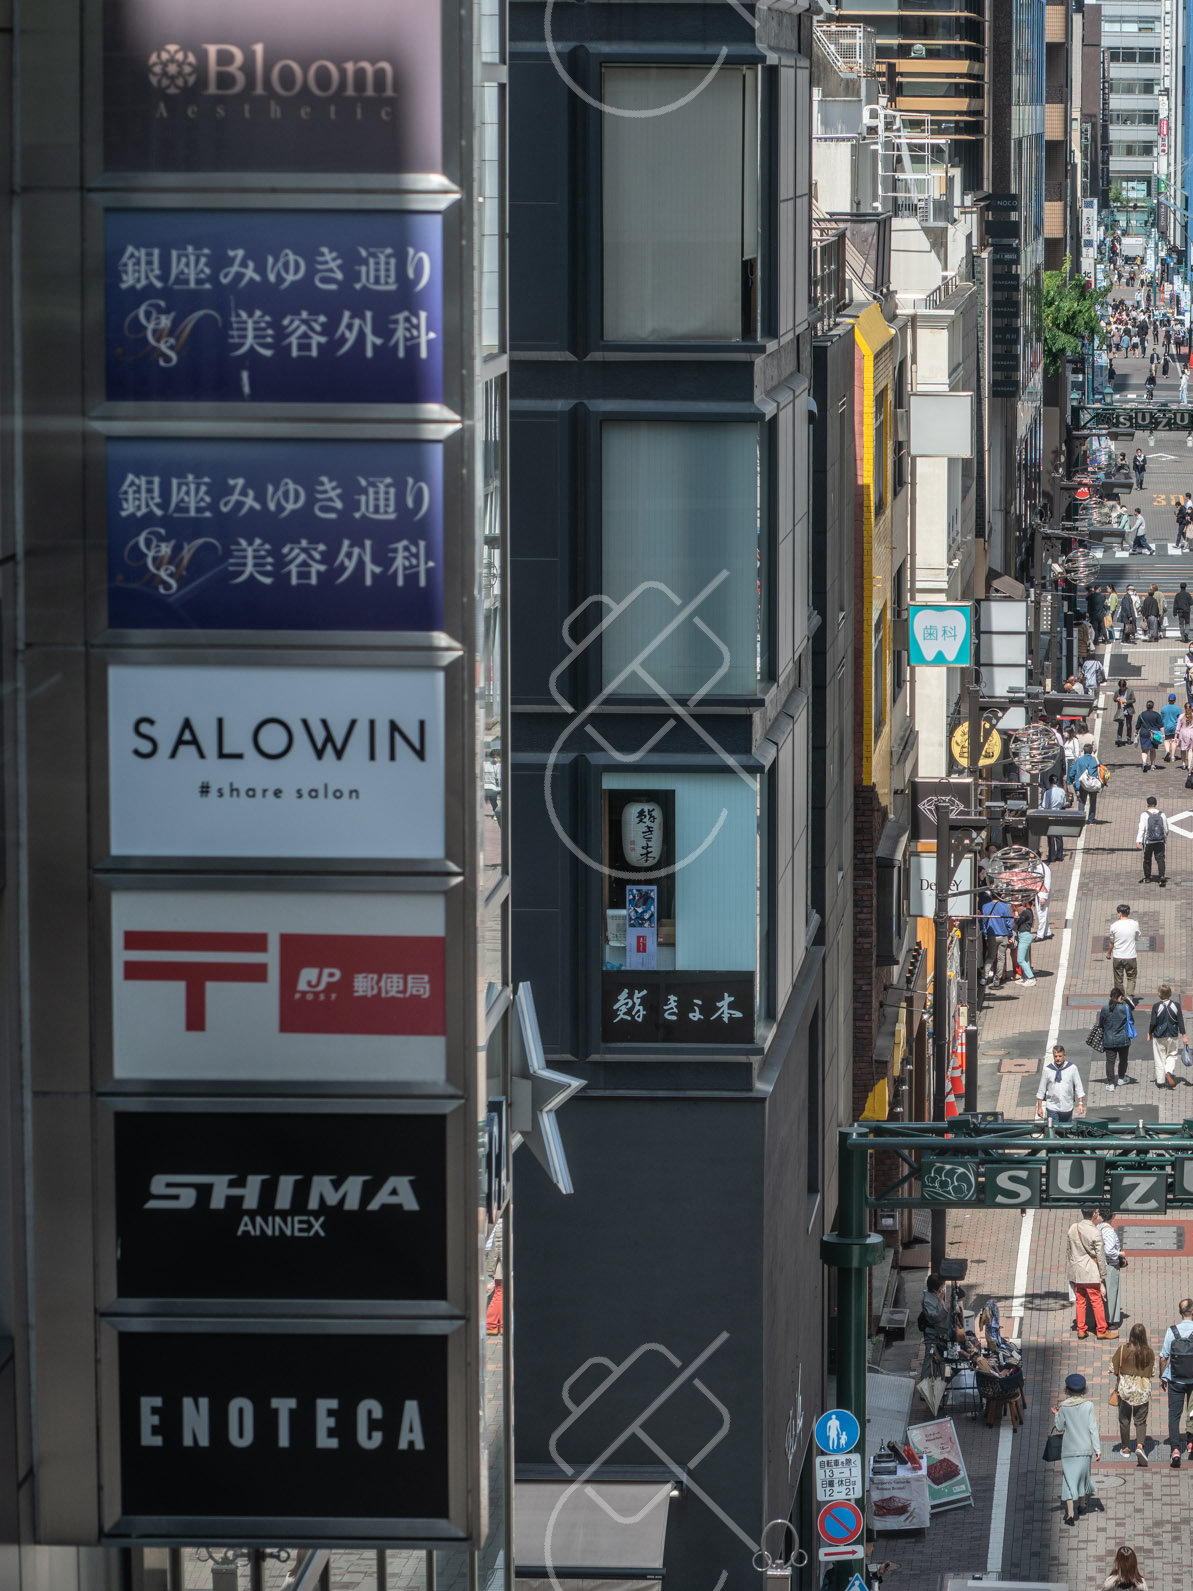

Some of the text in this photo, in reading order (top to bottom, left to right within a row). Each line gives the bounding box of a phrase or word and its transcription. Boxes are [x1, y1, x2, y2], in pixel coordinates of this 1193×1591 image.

[201, 42, 398, 98] Bloom
[155, 101, 393, 121] Aesthetic
[117, 245, 432, 292] 銀座みゆき通り
[227, 309, 437, 359] 美容外科
[117, 472, 432, 520] 銀座みゆき通り
[227, 537, 436, 587] 美容外科
[922, 625, 958, 642] 歯科
[132, 715, 427, 763] SALOWIN
[198, 782, 361, 800] #share salon
[352, 973, 430, 999] 郵便局
[143, 1174, 420, 1212] SHIMA
[237, 1215, 326, 1238] ANNEX
[139, 1395, 425, 1452] ENOTECA
